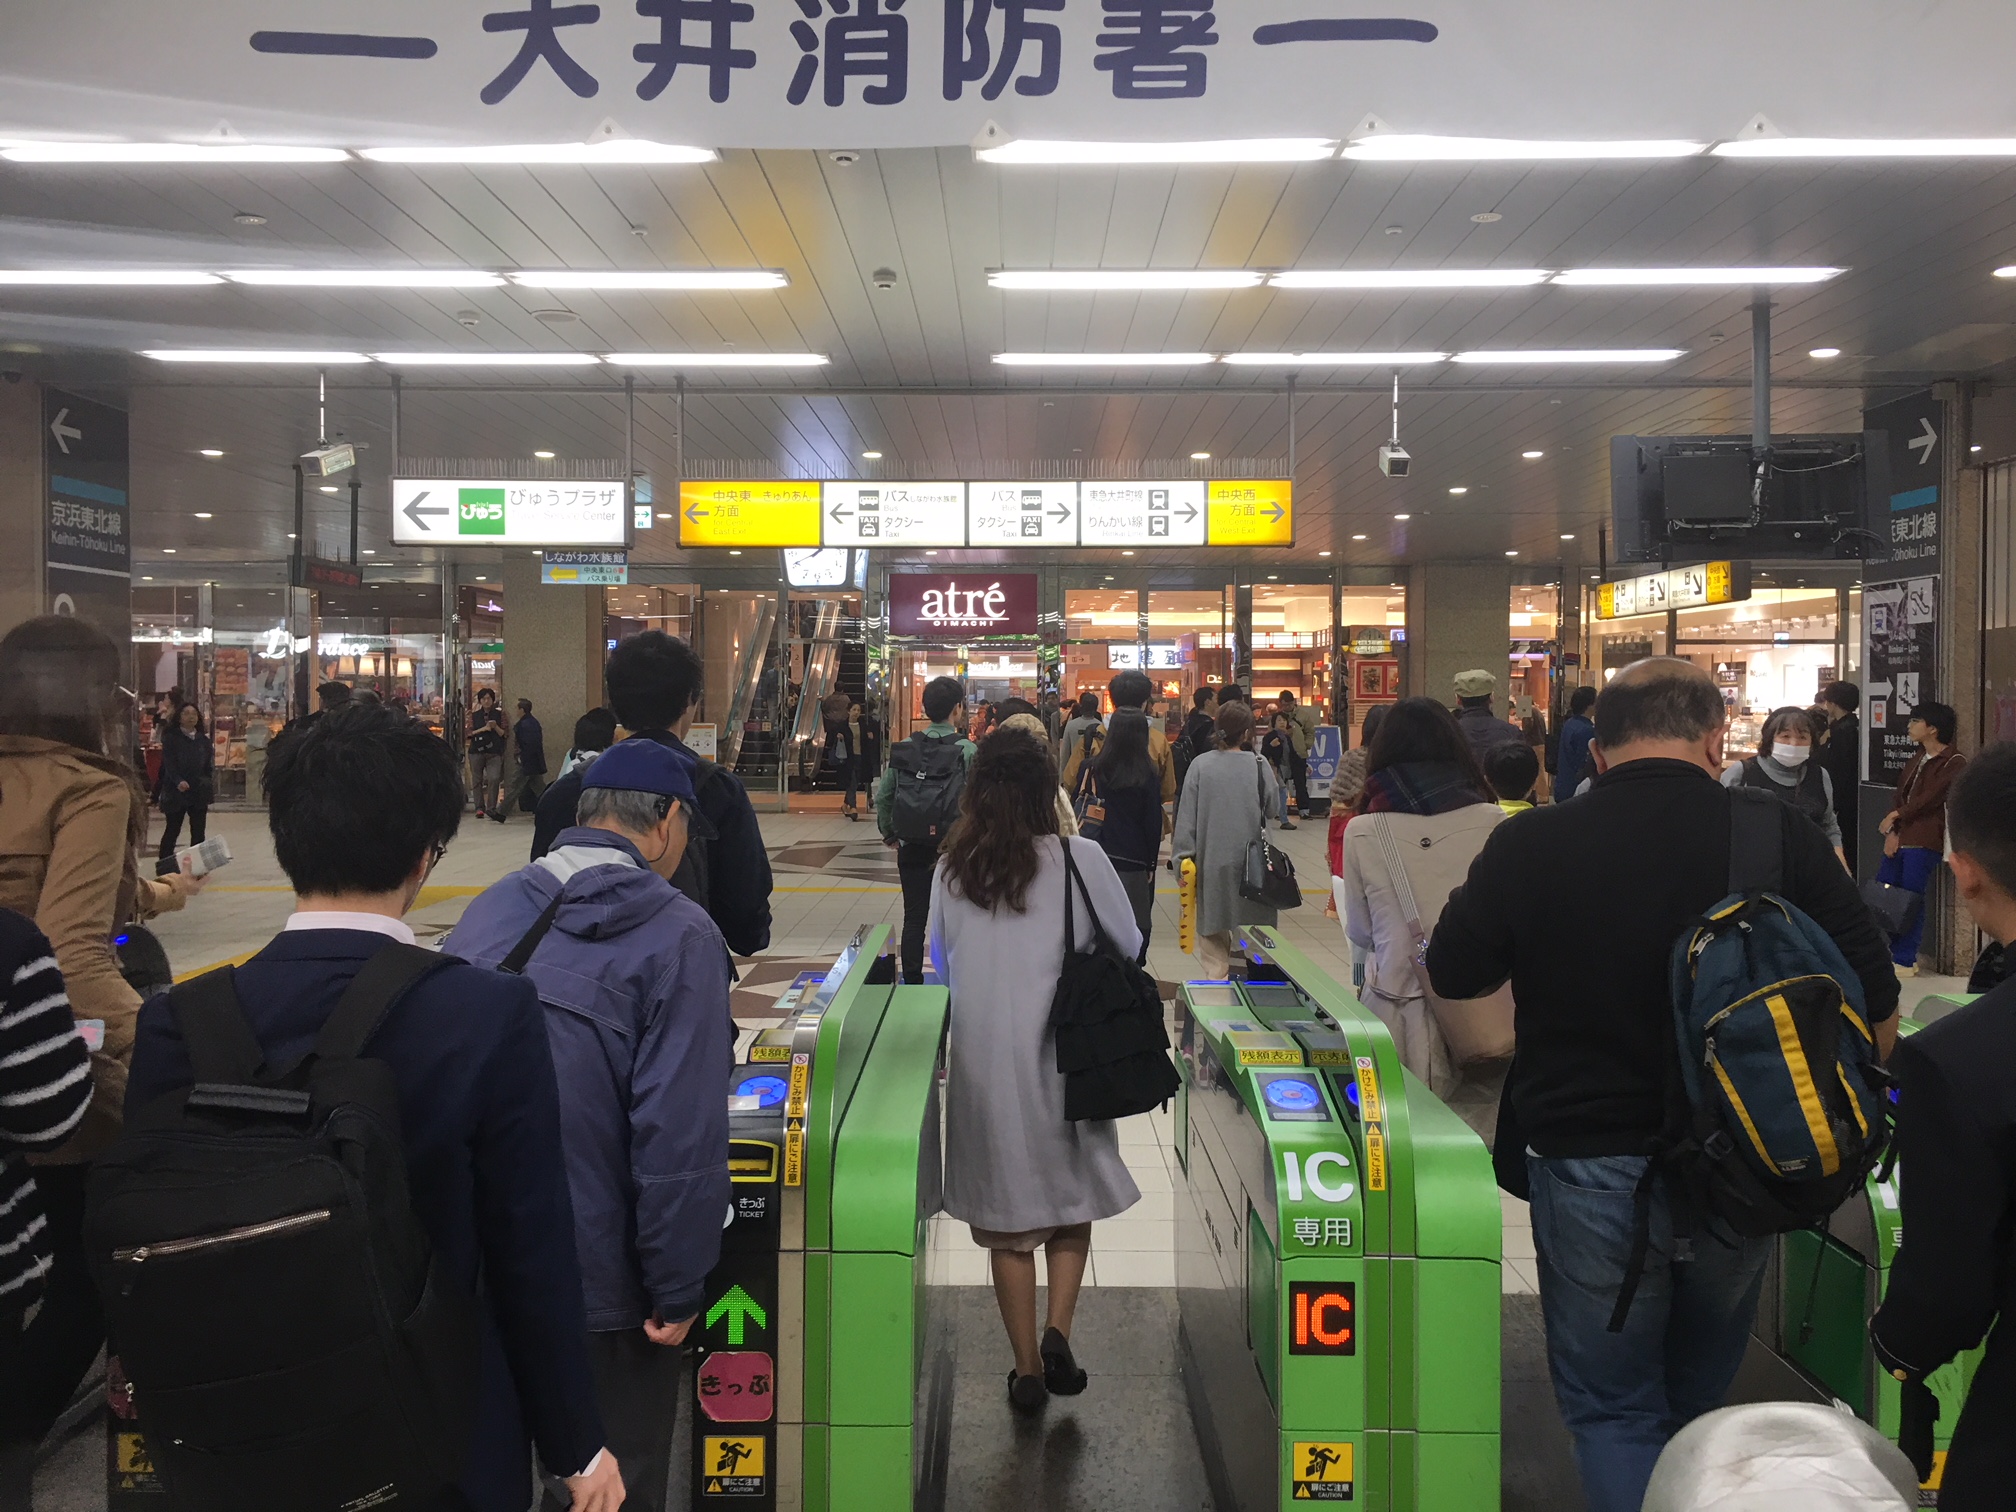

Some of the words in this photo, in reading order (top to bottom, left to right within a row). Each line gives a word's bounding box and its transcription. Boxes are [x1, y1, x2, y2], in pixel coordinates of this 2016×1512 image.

[480, 0, 1220, 106] 大井消防署
[510, 489, 616, 507] びゅうプラザ
[713, 490, 752, 503] 中央東
[762, 490, 812, 502] きゅりあん
[884, 490, 910, 503] バス
[991, 490, 1017, 502] バス
[1089, 490, 1143, 502] 東急大井町線
[1217, 489, 1256, 501] 中央西
[460, 504, 504, 520] びゅう
[713, 505, 740, 518] 方面
[1001, 504, 1017, 512] Bus
[1229, 504, 1256, 517] 方面
[51, 500, 122, 537] 京浜東北線
[582, 511, 616, 521] Center
[884, 516, 924, 528] タクシー
[976, 516, 1017, 528] タクシー
[1089, 516, 1143, 528] りんかい線
[713, 527, 730, 536] East
[732, 527, 747, 535] Exit
[884, 530, 900, 538] Taxi
[1002, 530, 1017, 538] Taxi
[1219, 527, 1237, 535] West
[1238, 527, 1257, 535] Exit
[109, 539, 127, 555] Line
[1891, 545, 1918, 562] ōhoku
[1919, 542, 1937, 559] Line
[545, 551, 626, 564] しながわ水族館
[586, 574, 622, 583] バス乗り場
[921, 582, 1006, 618] atré
[1241, 1050, 1300, 1061] 残額表示
[789, 1065, 805, 1116] かけこみ禁止
[1361, 1068, 1379, 1120] かけこみ禁止
[786, 1133, 800, 1184] 扉にご注意
[1369, 1137, 1384, 1189] 扉にご注意
[1283, 1151, 1355, 1203] IC
[738, 1197, 766, 1209] きっぷ
[738, 1210, 765, 1219] TICKET
[1292, 1217, 1352, 1248] 専用
[1296, 1293, 1351, 1346] IC
[700, 1374, 771, 1396] きっぷ
[722, 1478, 761, 1487] 扉にご注意
[1310, 1483, 1350, 1492] 扉にご注意
[1317, 1491, 1344, 1499] CAUTION
